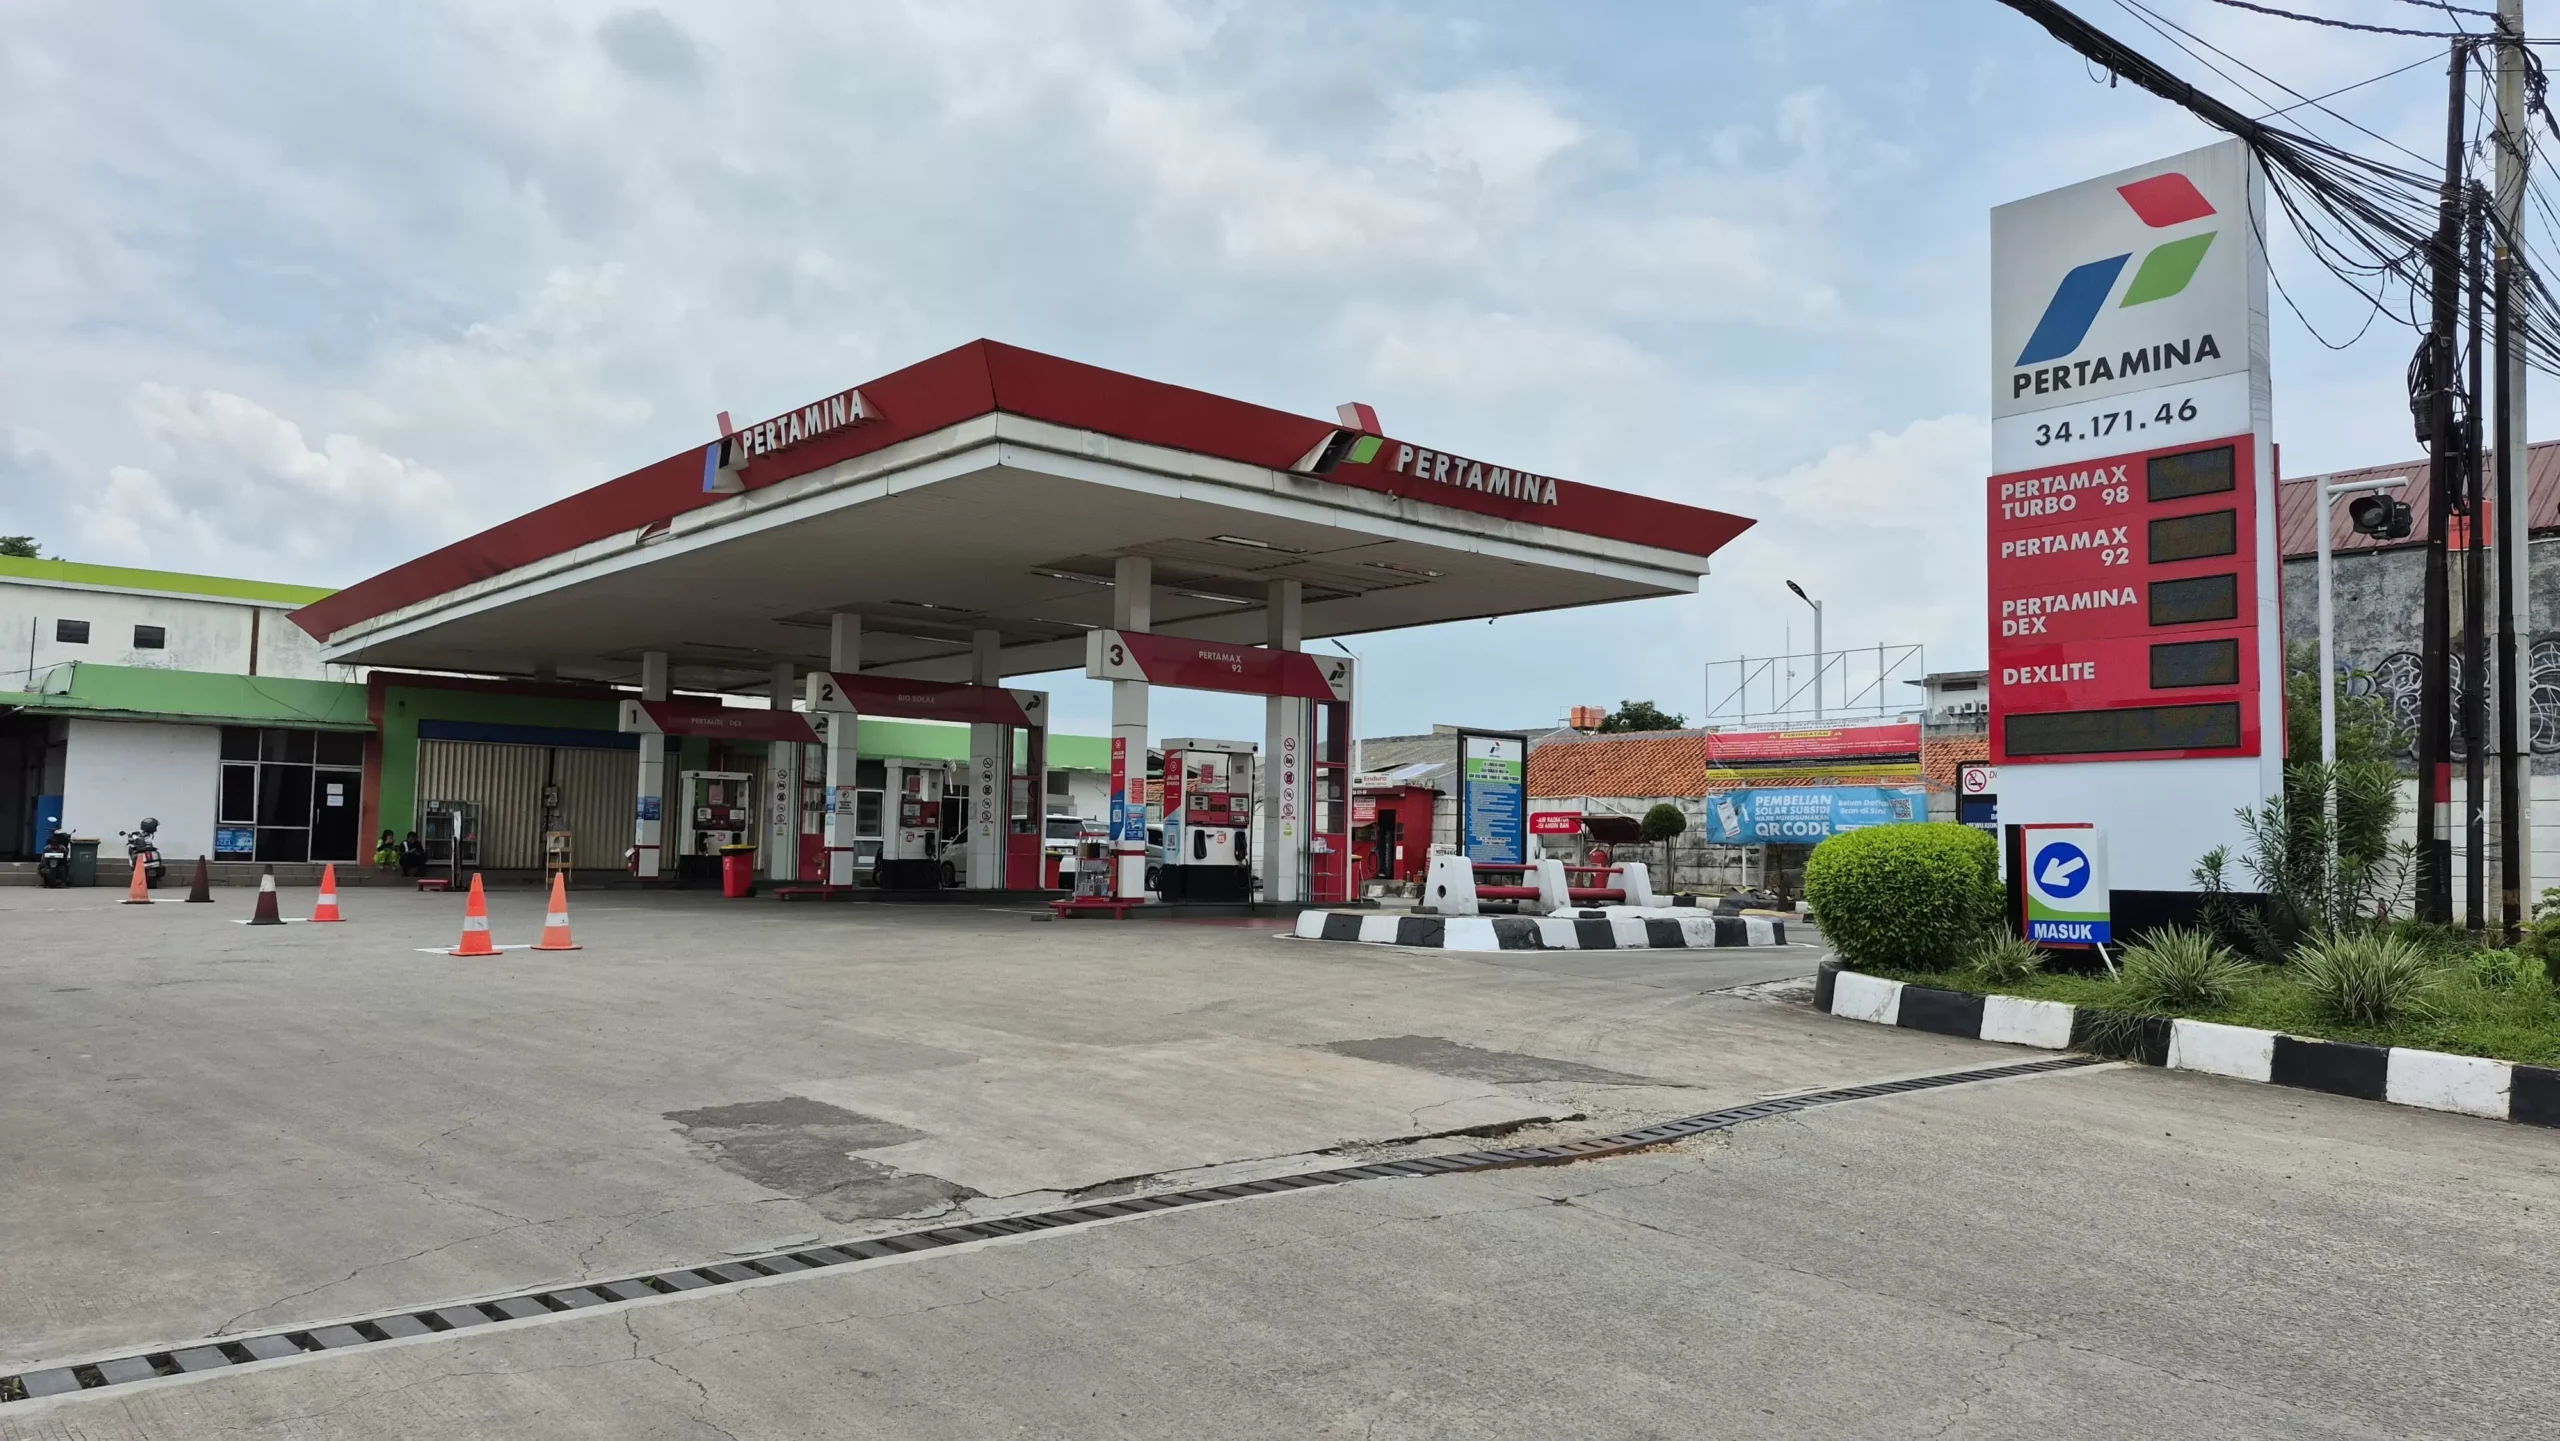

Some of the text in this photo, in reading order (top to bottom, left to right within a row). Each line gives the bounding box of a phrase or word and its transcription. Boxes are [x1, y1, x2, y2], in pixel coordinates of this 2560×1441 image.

[2013, 334, 2222, 399] PERTAMINA
[743, 389, 864, 459] PERTAMINA
[2035, 398, 2198, 446] 34.171.46
[1397, 444, 1558, 506] PERTAMINA
[2001, 465, 2128, 501] PERTAMAX
[2002, 485, 2130, 520] TURBO 98
[2001, 526, 2129, 559] PERTAMAX
[2101, 547, 2129, 566] 92
[2002, 587, 2138, 618] PERTAMINA
[2002, 616, 2047, 637] DEX
[1109, 644, 1124, 666] 3
[1198, 650, 1242, 664] PERTAMAX
[1231, 664, 1242, 673] 92
[2003, 661, 2095, 685] DEXLITE
[821, 684, 834, 702] 2
[898, 694, 936, 704] BIO SOLAR
[631, 709, 638, 724] 1
[1755, 795, 1832, 807] PEMBELIAN
[1755, 805, 1830, 816] SOLAR SUBSIDI
[1870, 807, 1886, 815] Sini
[1755, 821, 1830, 837] QR CODE
[2034, 923, 2093, 940] MASUK
